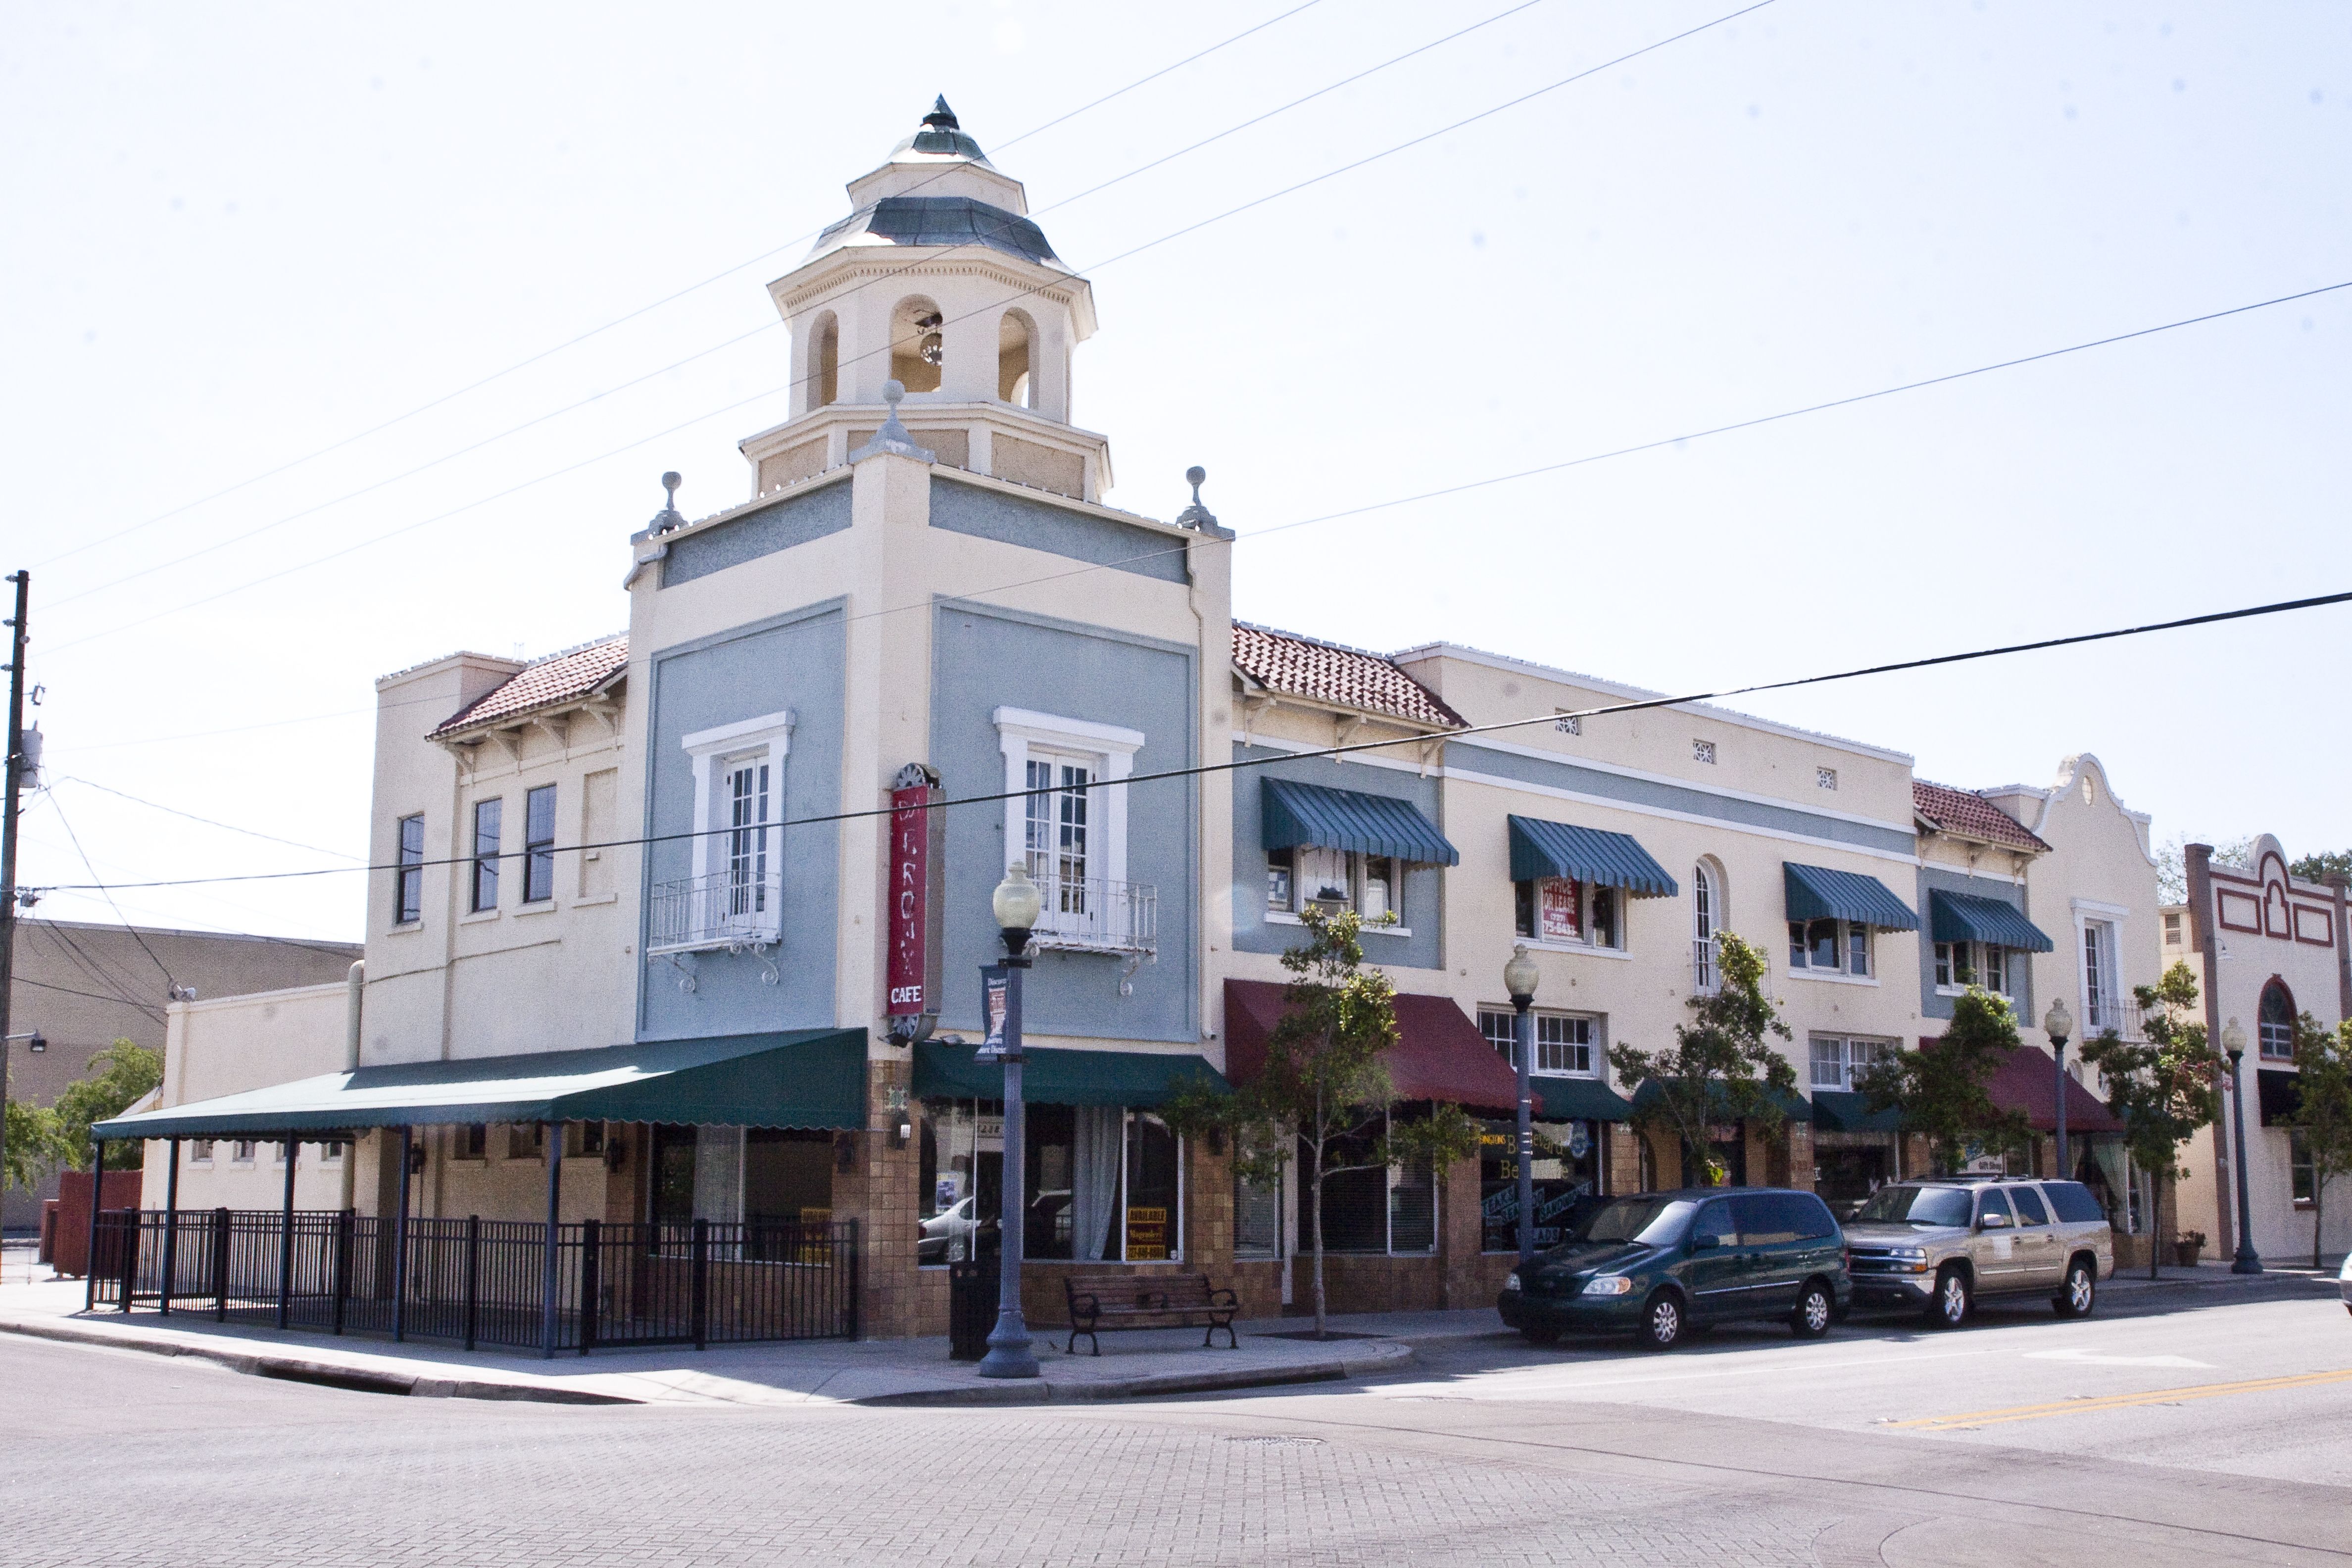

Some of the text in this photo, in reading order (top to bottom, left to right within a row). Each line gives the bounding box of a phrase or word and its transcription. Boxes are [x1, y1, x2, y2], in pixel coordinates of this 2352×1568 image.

[891, 985, 922, 1004] CAFE
[1507, 1134, 1564, 1156] Bevard
[1481, 1188, 1515, 1216] TEAKS
